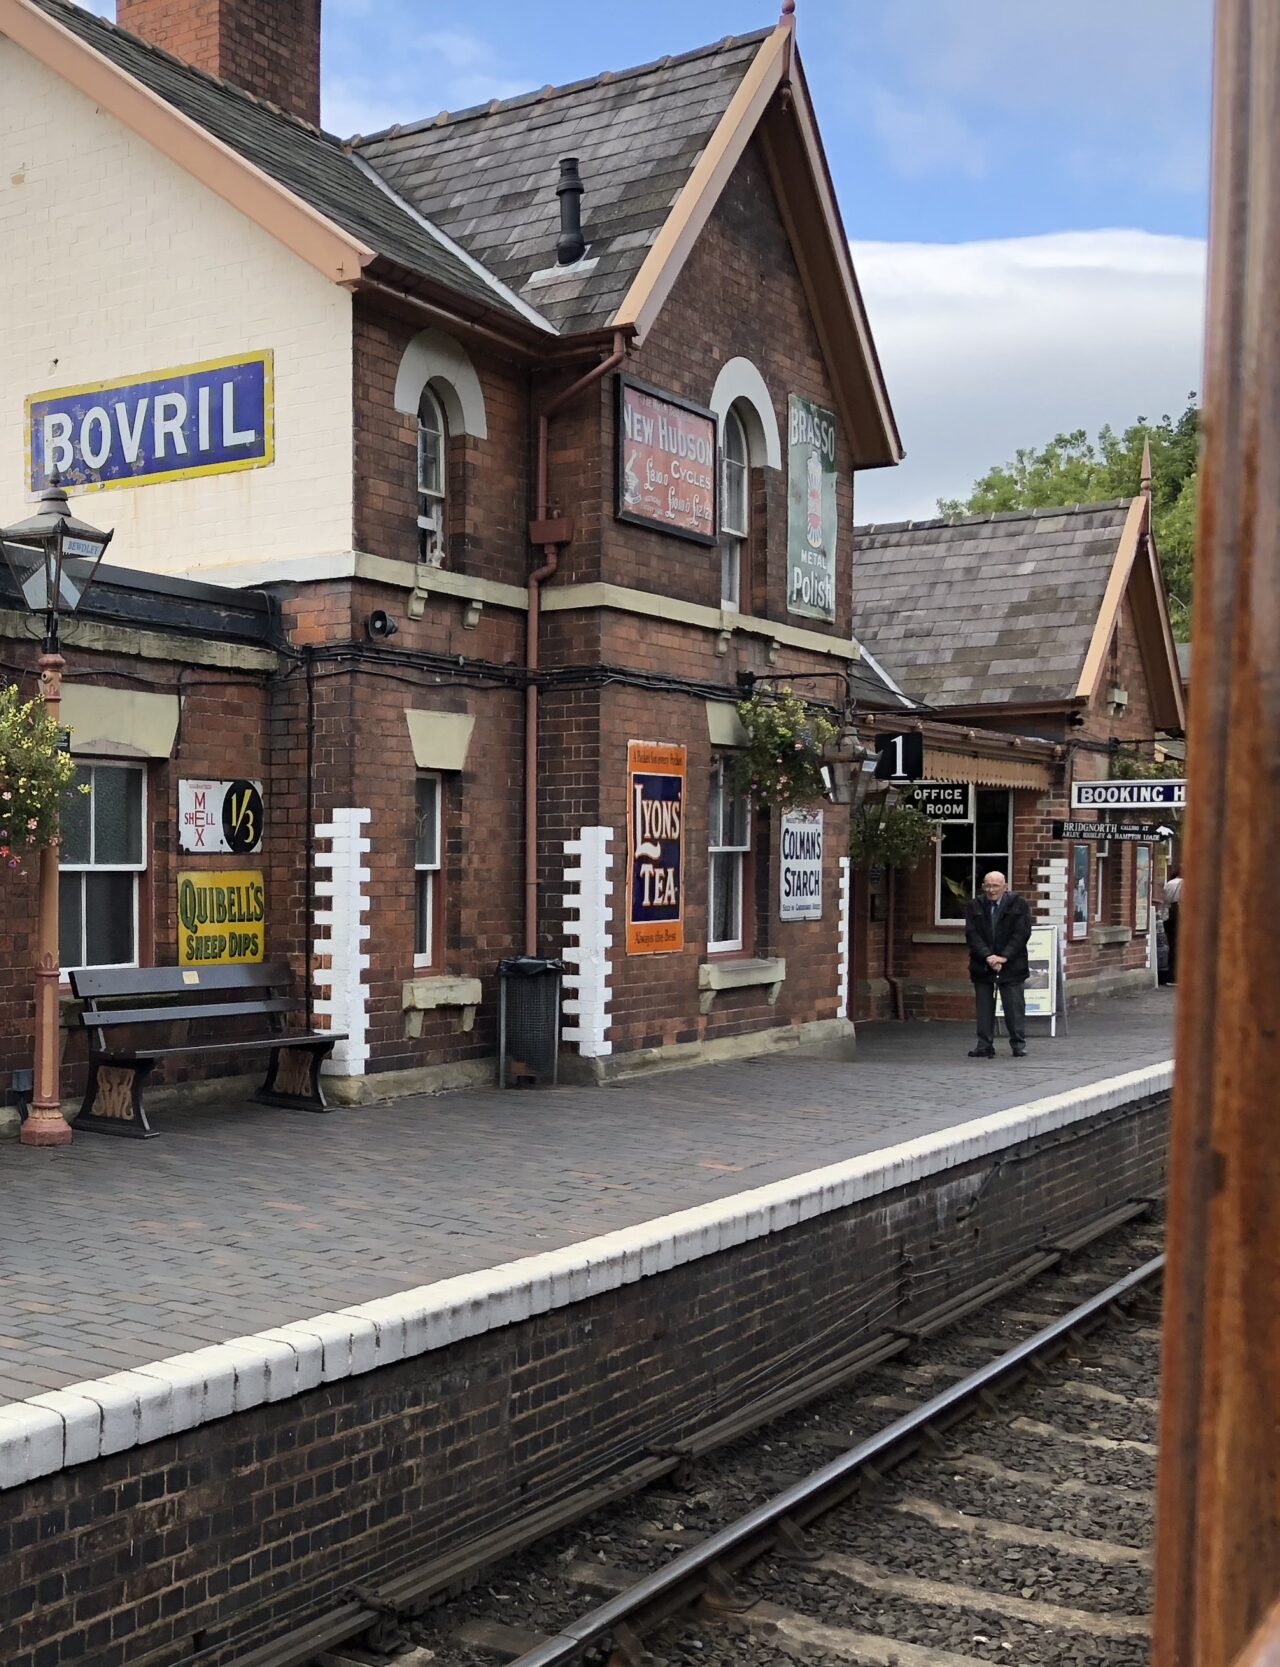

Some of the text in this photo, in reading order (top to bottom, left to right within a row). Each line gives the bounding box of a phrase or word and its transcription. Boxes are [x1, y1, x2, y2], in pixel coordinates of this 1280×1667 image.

[44, 382, 256, 476] BOVRIL
[624, 403, 654, 447] NEW
[658, 415, 713, 467] HUDSON
[791, 406, 835, 462] BRASSO
[671, 460, 711, 490] CYCLES
[68, 540, 99, 555] BEWDLEY
[801, 549, 827, 569] METAL
[793, 566, 832, 609] Polish
[891, 735, 907, 777] 1
[914, 789, 962, 800] OFFICE
[926, 804, 964, 815] ROOM
[1081, 786, 1164, 803] BOOKING
[184, 810, 216, 828] SHELL
[1063, 821, 1117, 834] BRIDGNORTH
[782, 828, 822, 860] COLMAN'S
[784, 867, 820, 897] STARCH
[180, 878, 265, 935] QUIBELL'S
[186, 931, 259, 961] SHEEP DIPS
